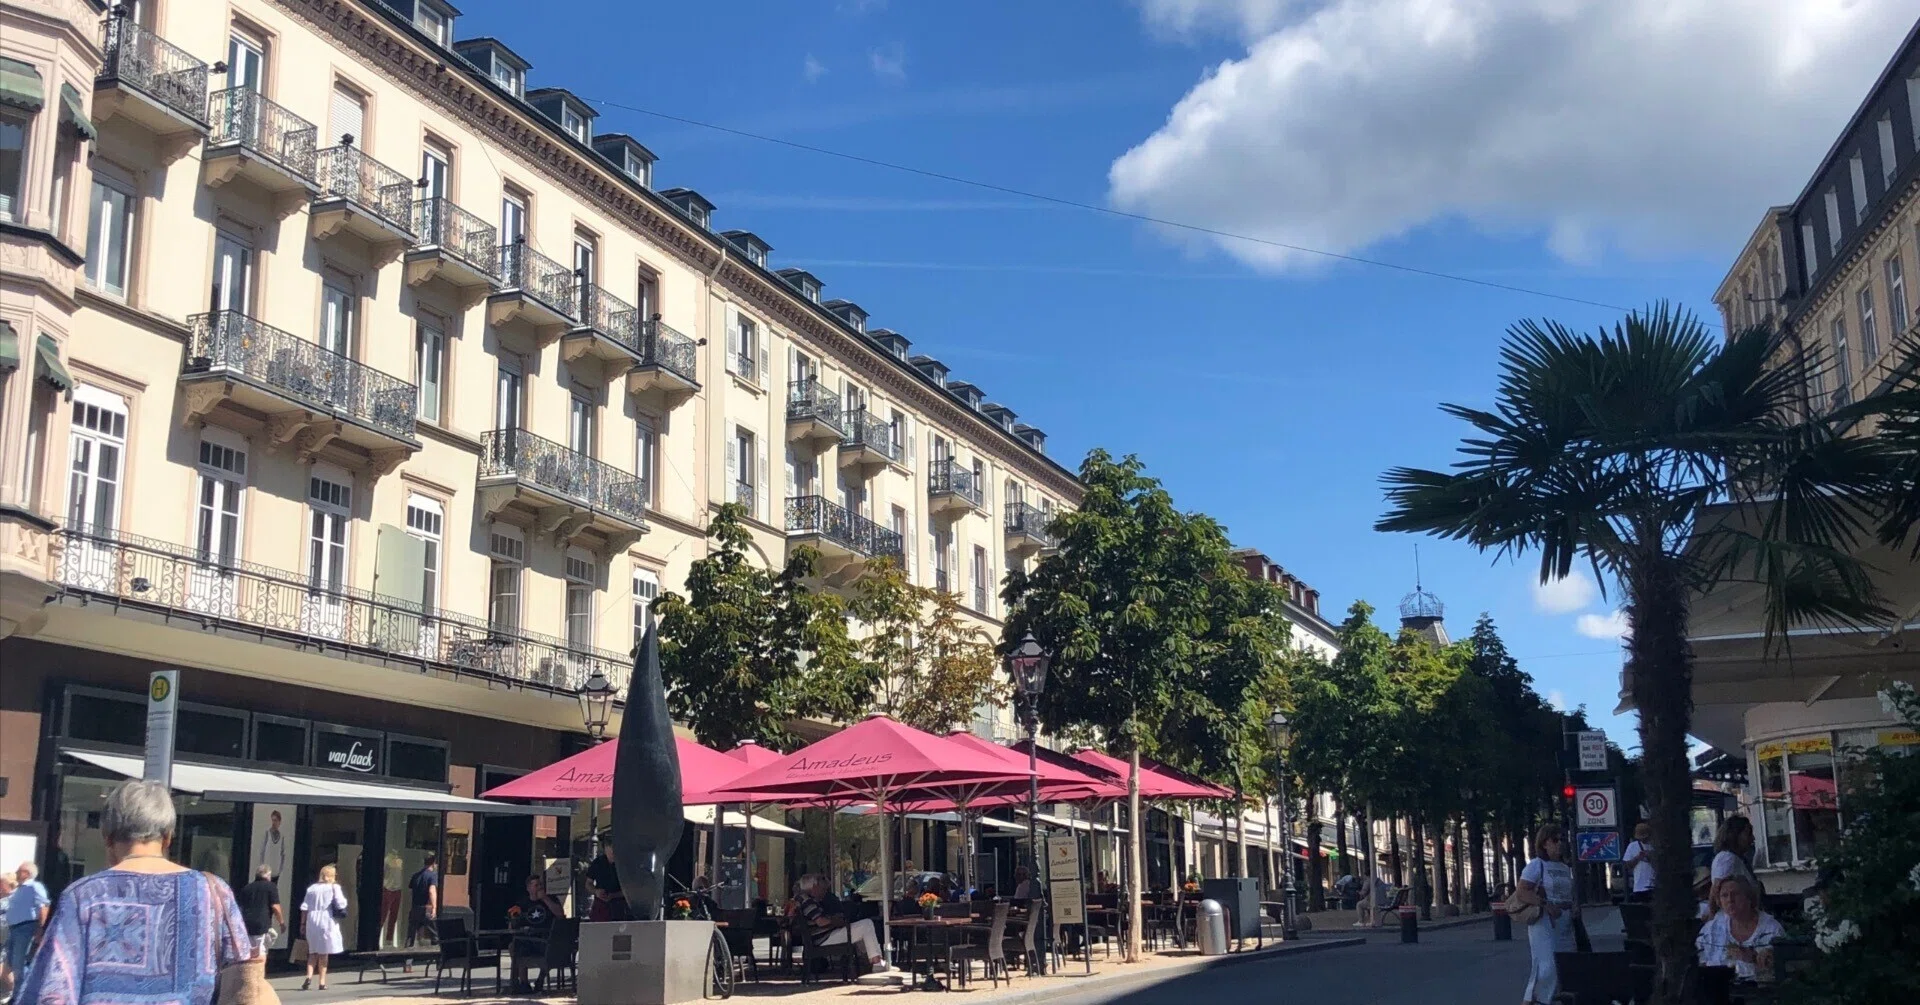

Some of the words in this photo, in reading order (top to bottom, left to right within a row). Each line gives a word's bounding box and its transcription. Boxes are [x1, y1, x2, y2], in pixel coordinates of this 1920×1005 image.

[328, 751, 347, 763] van
[341, 741, 376, 772] Laack
[787, 753, 893, 770] Amadeus
[1588, 798, 1604, 811] 30
[1587, 817, 1607, 825] ZONE
